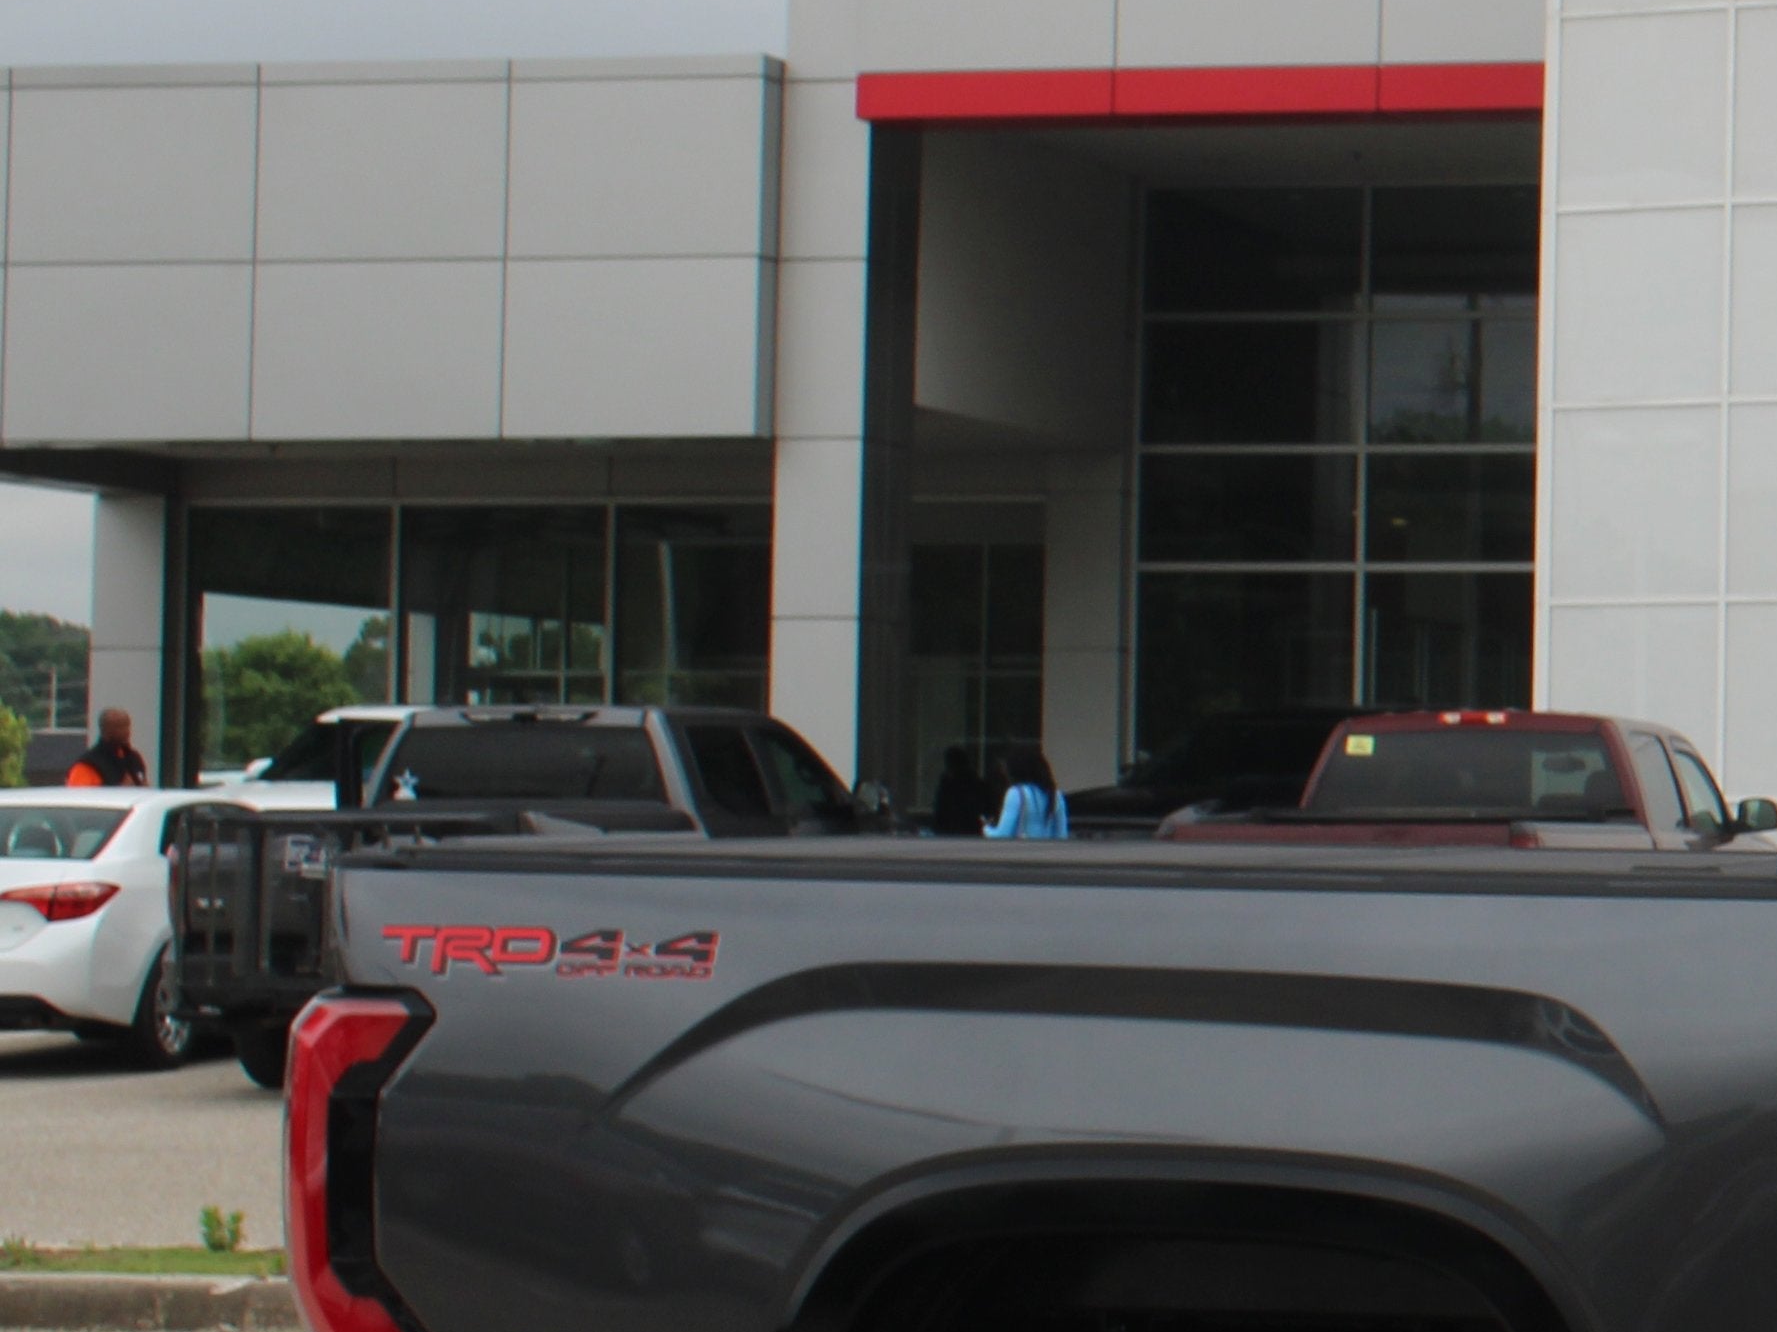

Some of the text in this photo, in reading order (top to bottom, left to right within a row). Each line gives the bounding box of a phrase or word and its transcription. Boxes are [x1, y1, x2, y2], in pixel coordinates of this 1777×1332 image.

[383, 925, 556, 975] TRD
[556, 963, 714, 980] OFF ROAD
